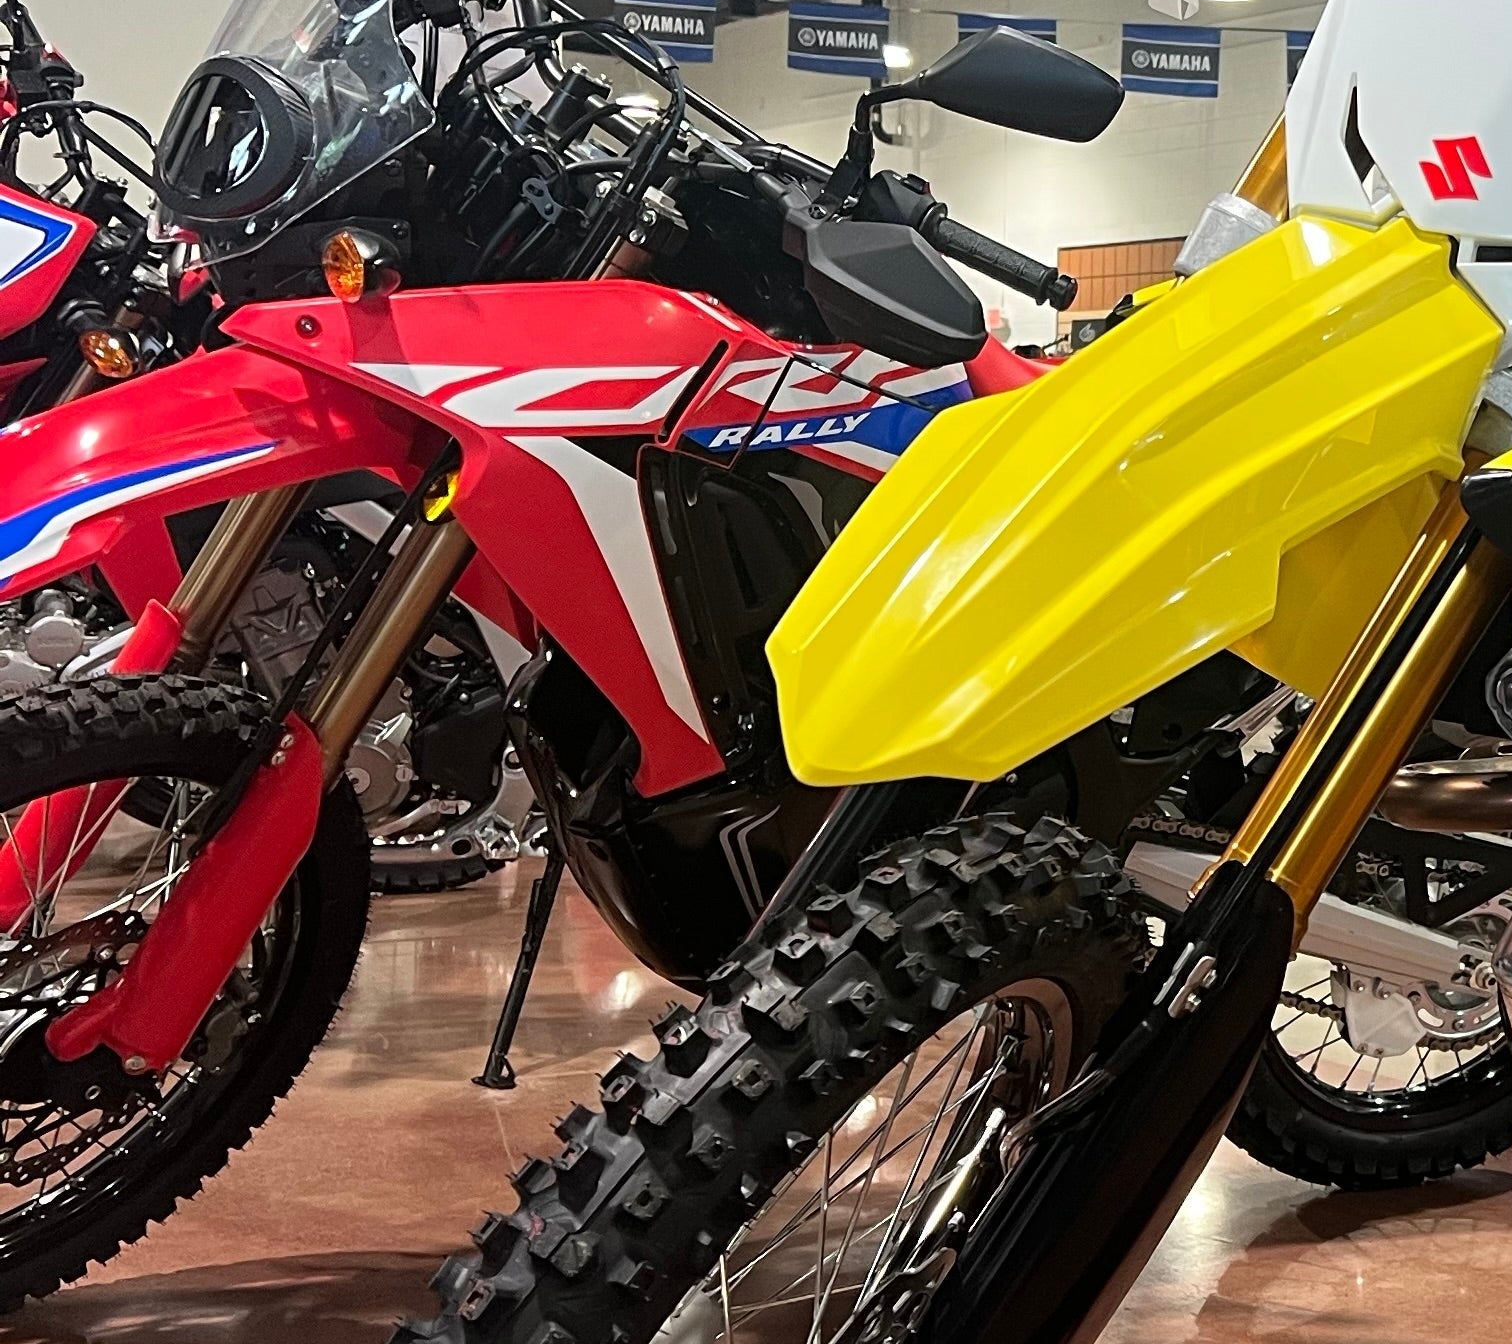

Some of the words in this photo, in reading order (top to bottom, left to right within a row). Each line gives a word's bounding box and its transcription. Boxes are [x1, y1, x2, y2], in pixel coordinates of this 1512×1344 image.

[642, 14, 705, 36] YAMAHA
[817, 29, 878, 50] YAMAHA
[1150, 53, 1211, 72] YAMAHA
[708, 411, 871, 448] RALLY
